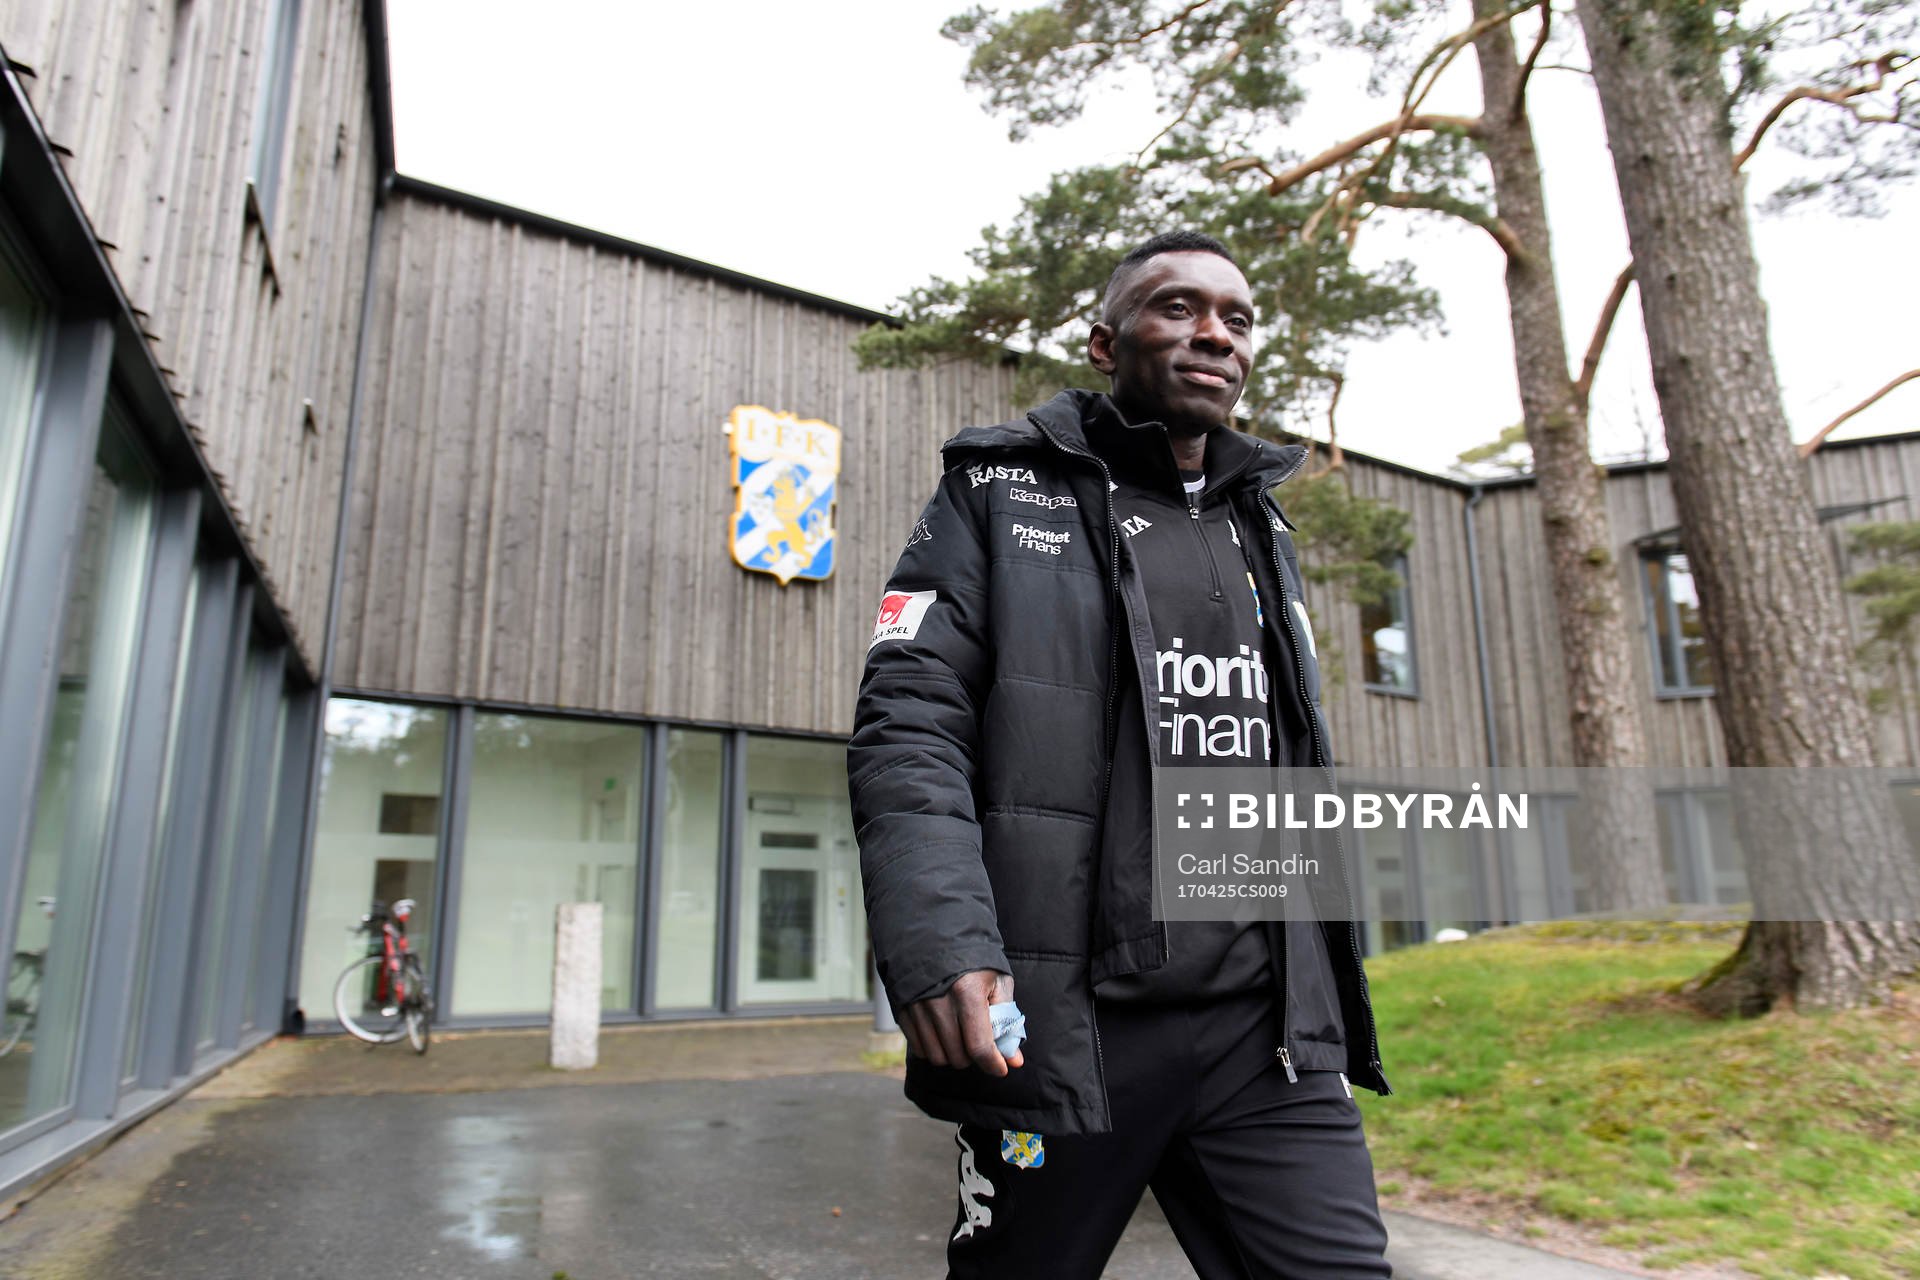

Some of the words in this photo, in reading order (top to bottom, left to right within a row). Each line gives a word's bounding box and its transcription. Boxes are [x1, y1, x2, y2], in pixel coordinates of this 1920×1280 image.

[968, 466, 1038, 489] RASTA
[1009, 487, 1078, 510] Kappa
[1012, 523, 1071, 543] Prioritet
[1019, 536, 1062, 555] Finans
[886, 626, 909, 636] SPEL
[1156, 637, 1269, 704] riorit
